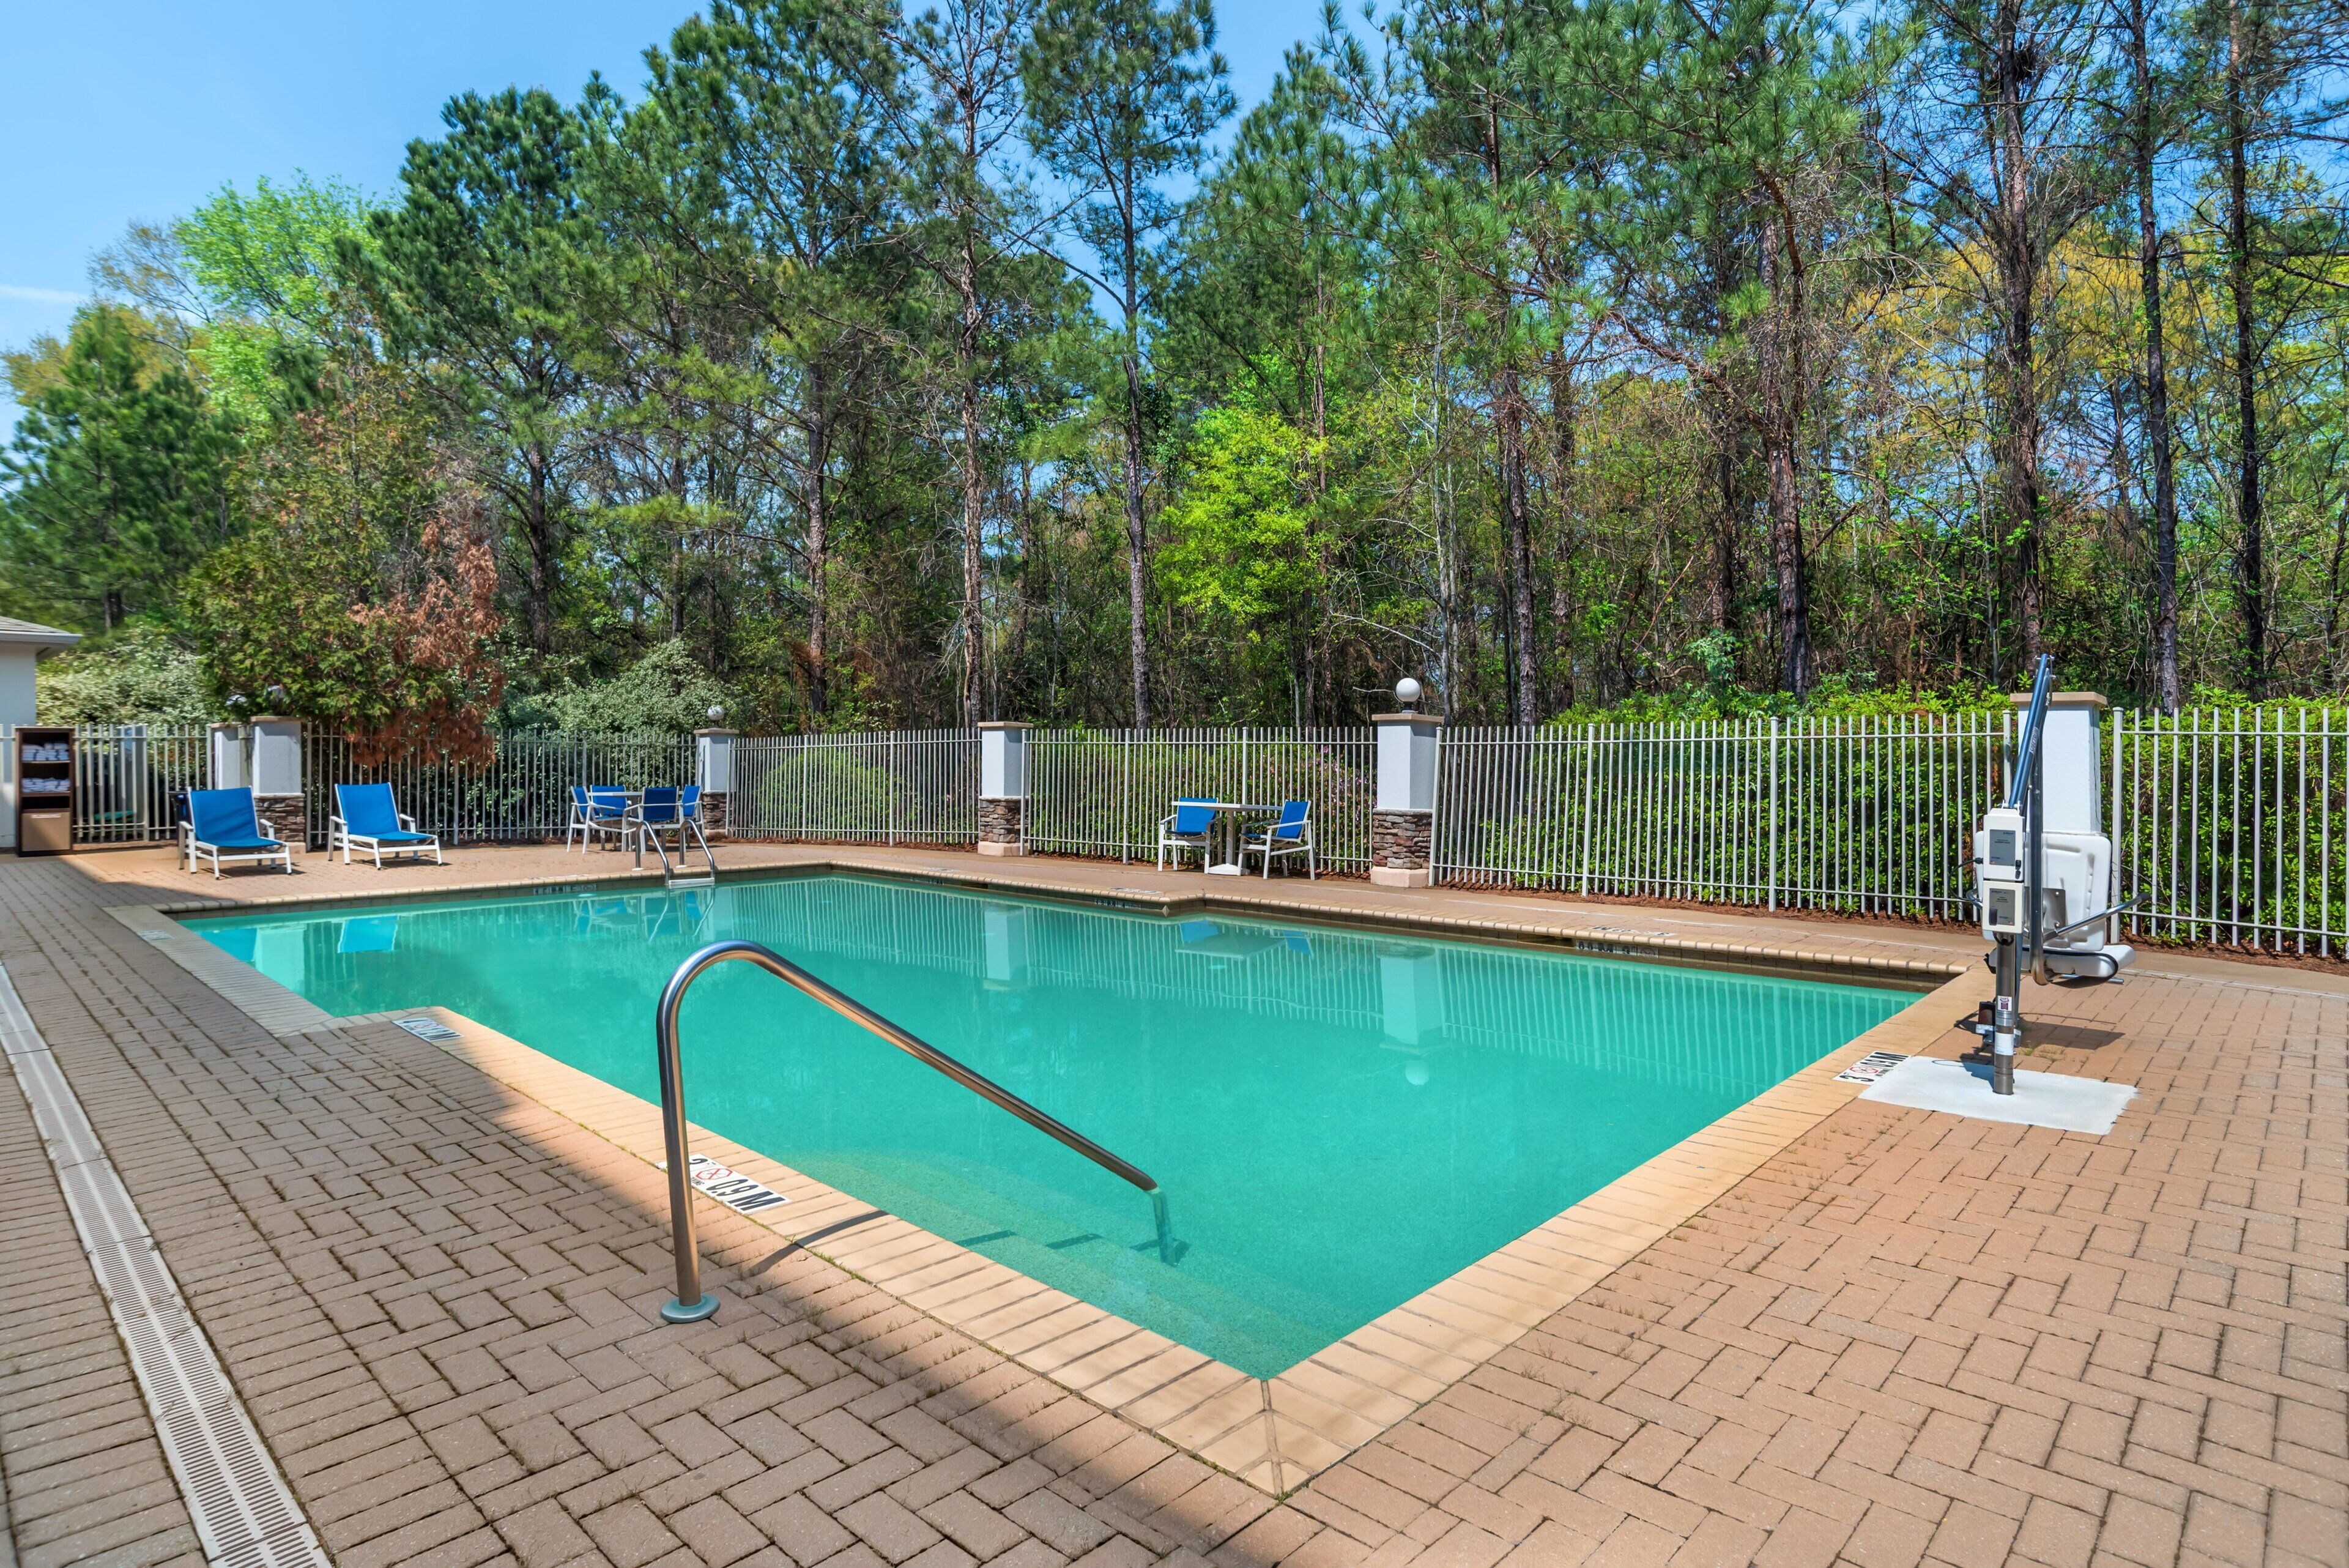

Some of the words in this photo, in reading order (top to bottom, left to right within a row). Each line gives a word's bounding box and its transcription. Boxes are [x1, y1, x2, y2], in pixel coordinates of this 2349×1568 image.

[1869, 1052, 1909, 1061] M
[706, 1179, 759, 1197] 0.9
[727, 1191, 786, 1211] M
